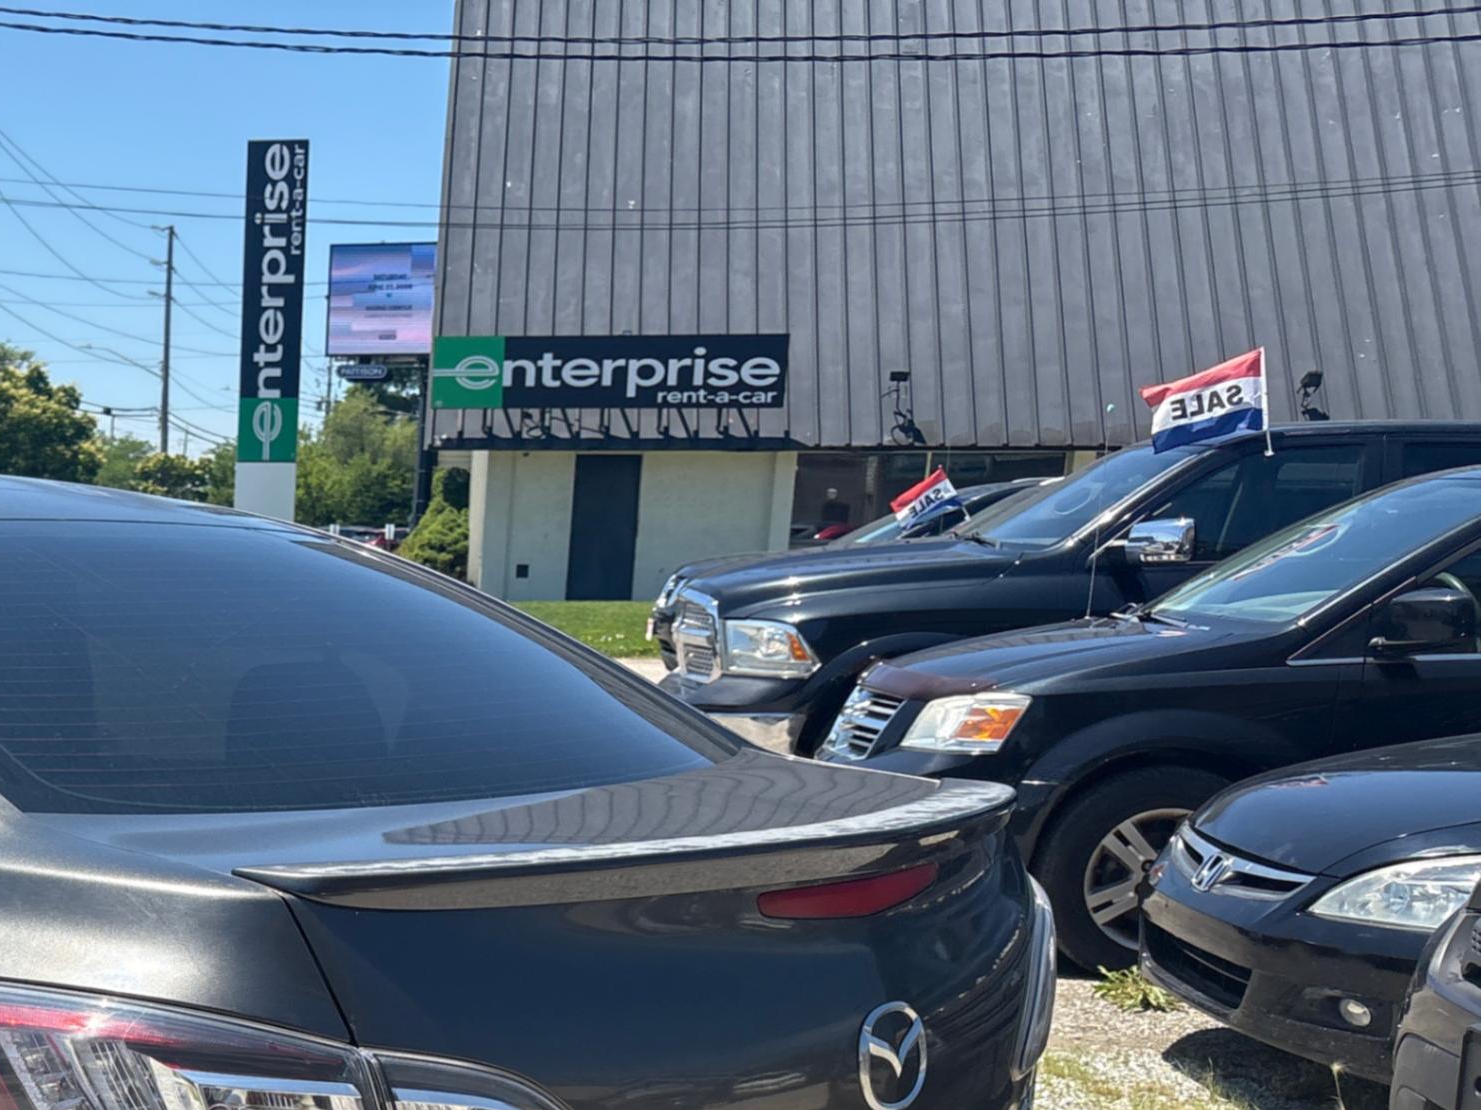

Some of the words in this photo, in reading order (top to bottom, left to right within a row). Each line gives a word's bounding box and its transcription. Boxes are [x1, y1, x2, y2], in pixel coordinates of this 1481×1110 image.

[290, 144, 307, 255] rent-a-car
[252, 143, 296, 461] enterprise
[433, 347, 781, 398] enterprise
[656, 389, 777, 404] rent-a-car
